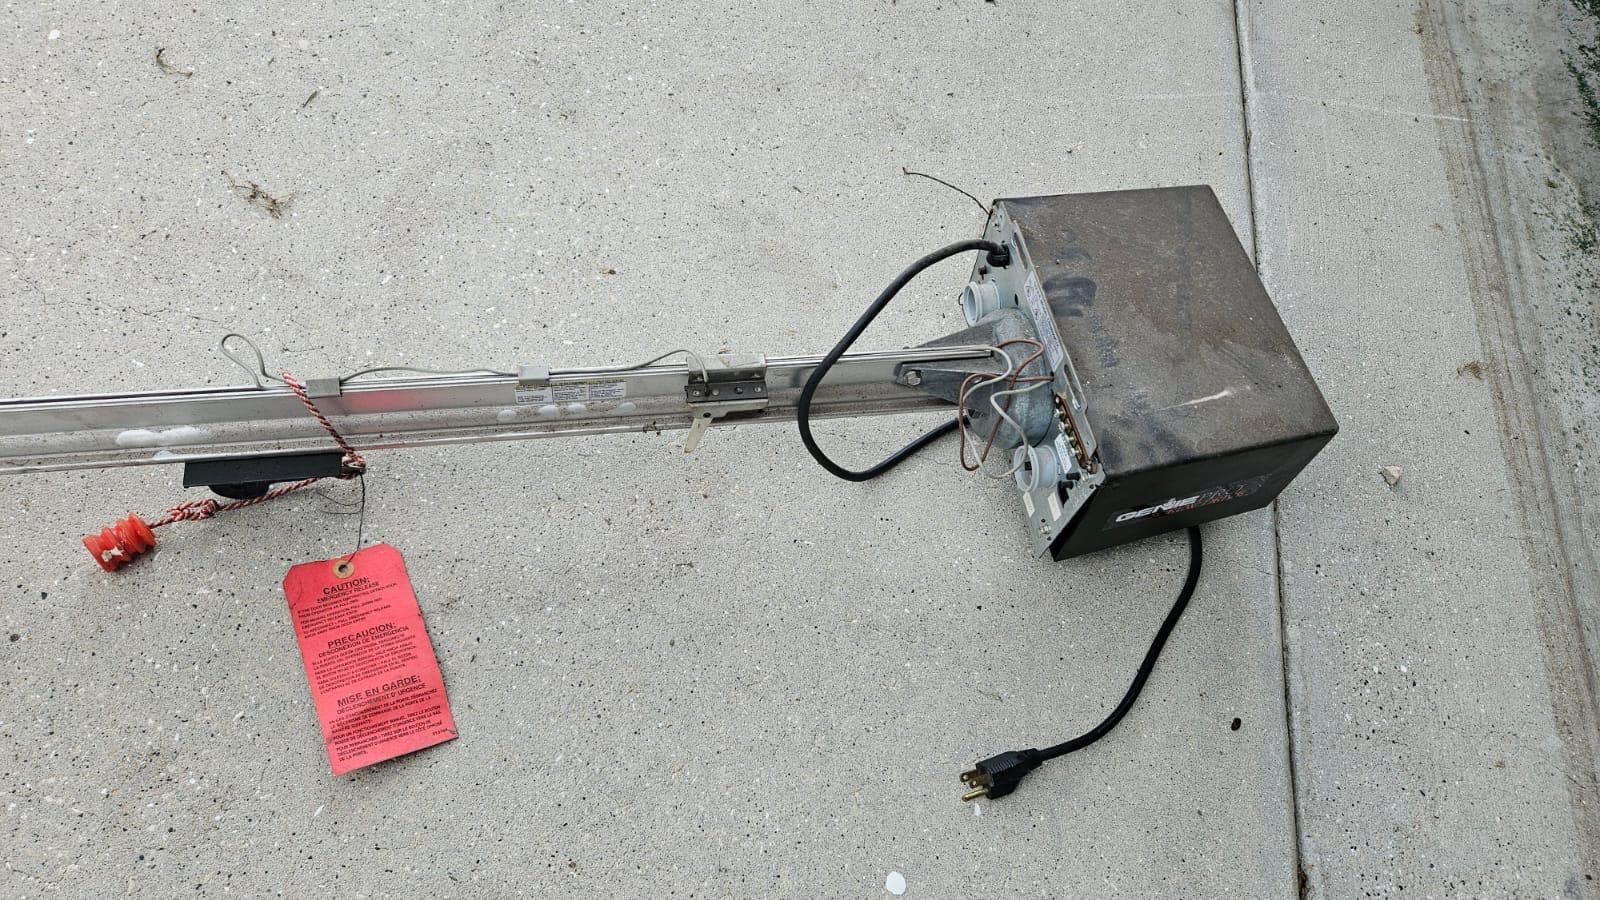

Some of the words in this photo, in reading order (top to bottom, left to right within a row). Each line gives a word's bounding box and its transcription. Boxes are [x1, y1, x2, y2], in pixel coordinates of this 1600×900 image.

[1115, 496, 1200, 522] GENIE
[323, 576, 370, 596] CAUTION:
[353, 581, 380, 593] RELEASE
[327, 621, 396, 649] PRECAUCION:
[337, 692, 363, 706] MISE
[365, 686, 382, 698] EN
[382, 674, 422, 692] GARDE:
[398, 682, 426, 695] URGENCE
